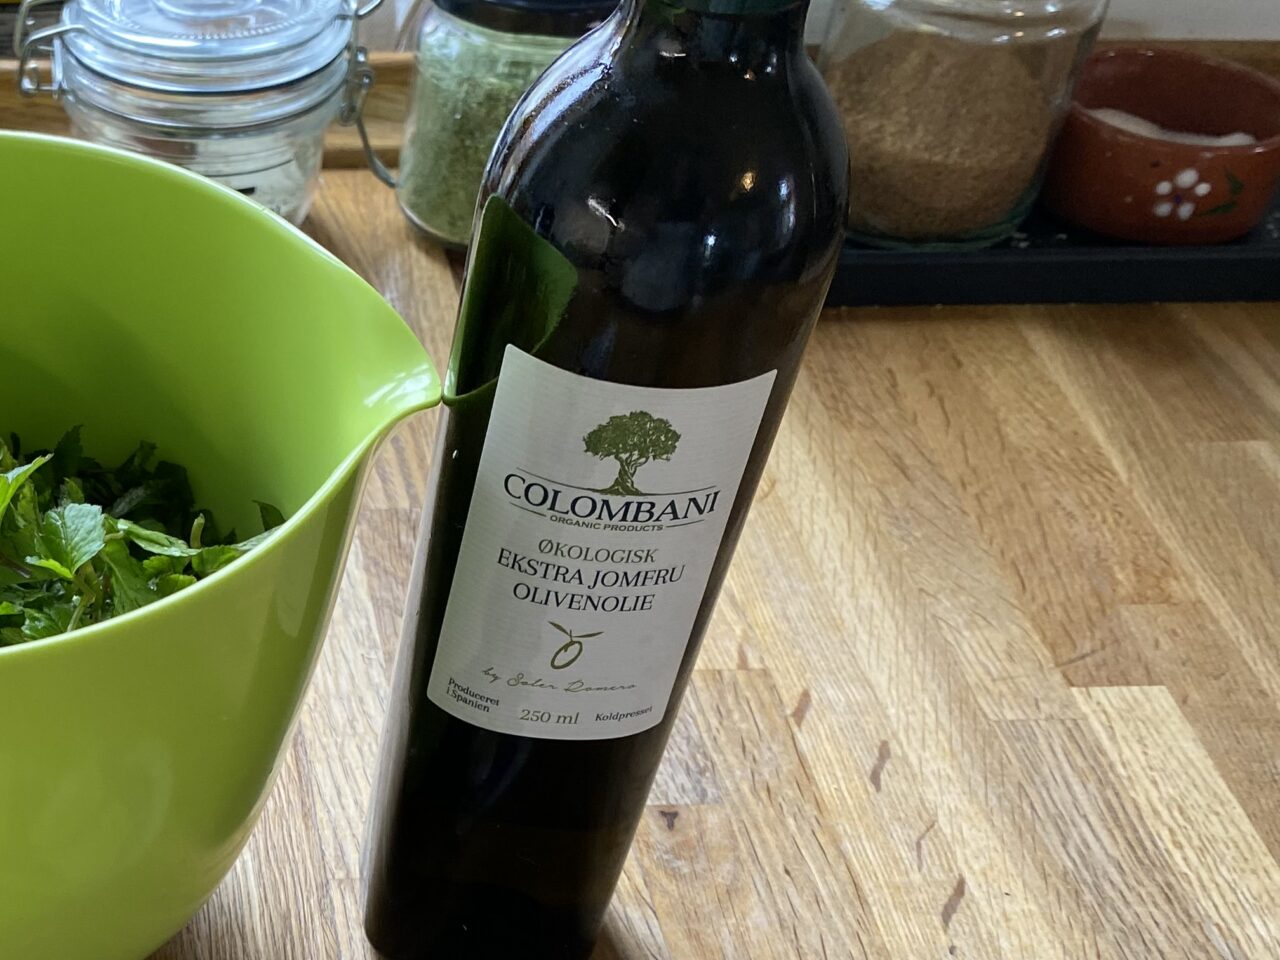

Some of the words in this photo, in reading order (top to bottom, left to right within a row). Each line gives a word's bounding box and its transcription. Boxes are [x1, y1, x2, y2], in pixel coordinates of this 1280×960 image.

[504, 473, 720, 523] COLOMBANI
[550, 514, 601, 530] ORGANIC
[603, 523, 663, 532] PRODUCTS
[538, 539, 658, 563] ØKOLOGISK
[497, 547, 584, 585] EKSTRA
[588, 565, 686, 589] JOMFRU
[513, 582, 655, 612] OLIVENOLIE
[482, 666, 501, 683] by
[448, 677, 500, 706] Produceret
[451, 688, 490, 713] Spanien
[520, 709, 551, 724] 250
[556, 711, 580, 725] ml
[595, 705, 652, 722] Koldpresset
